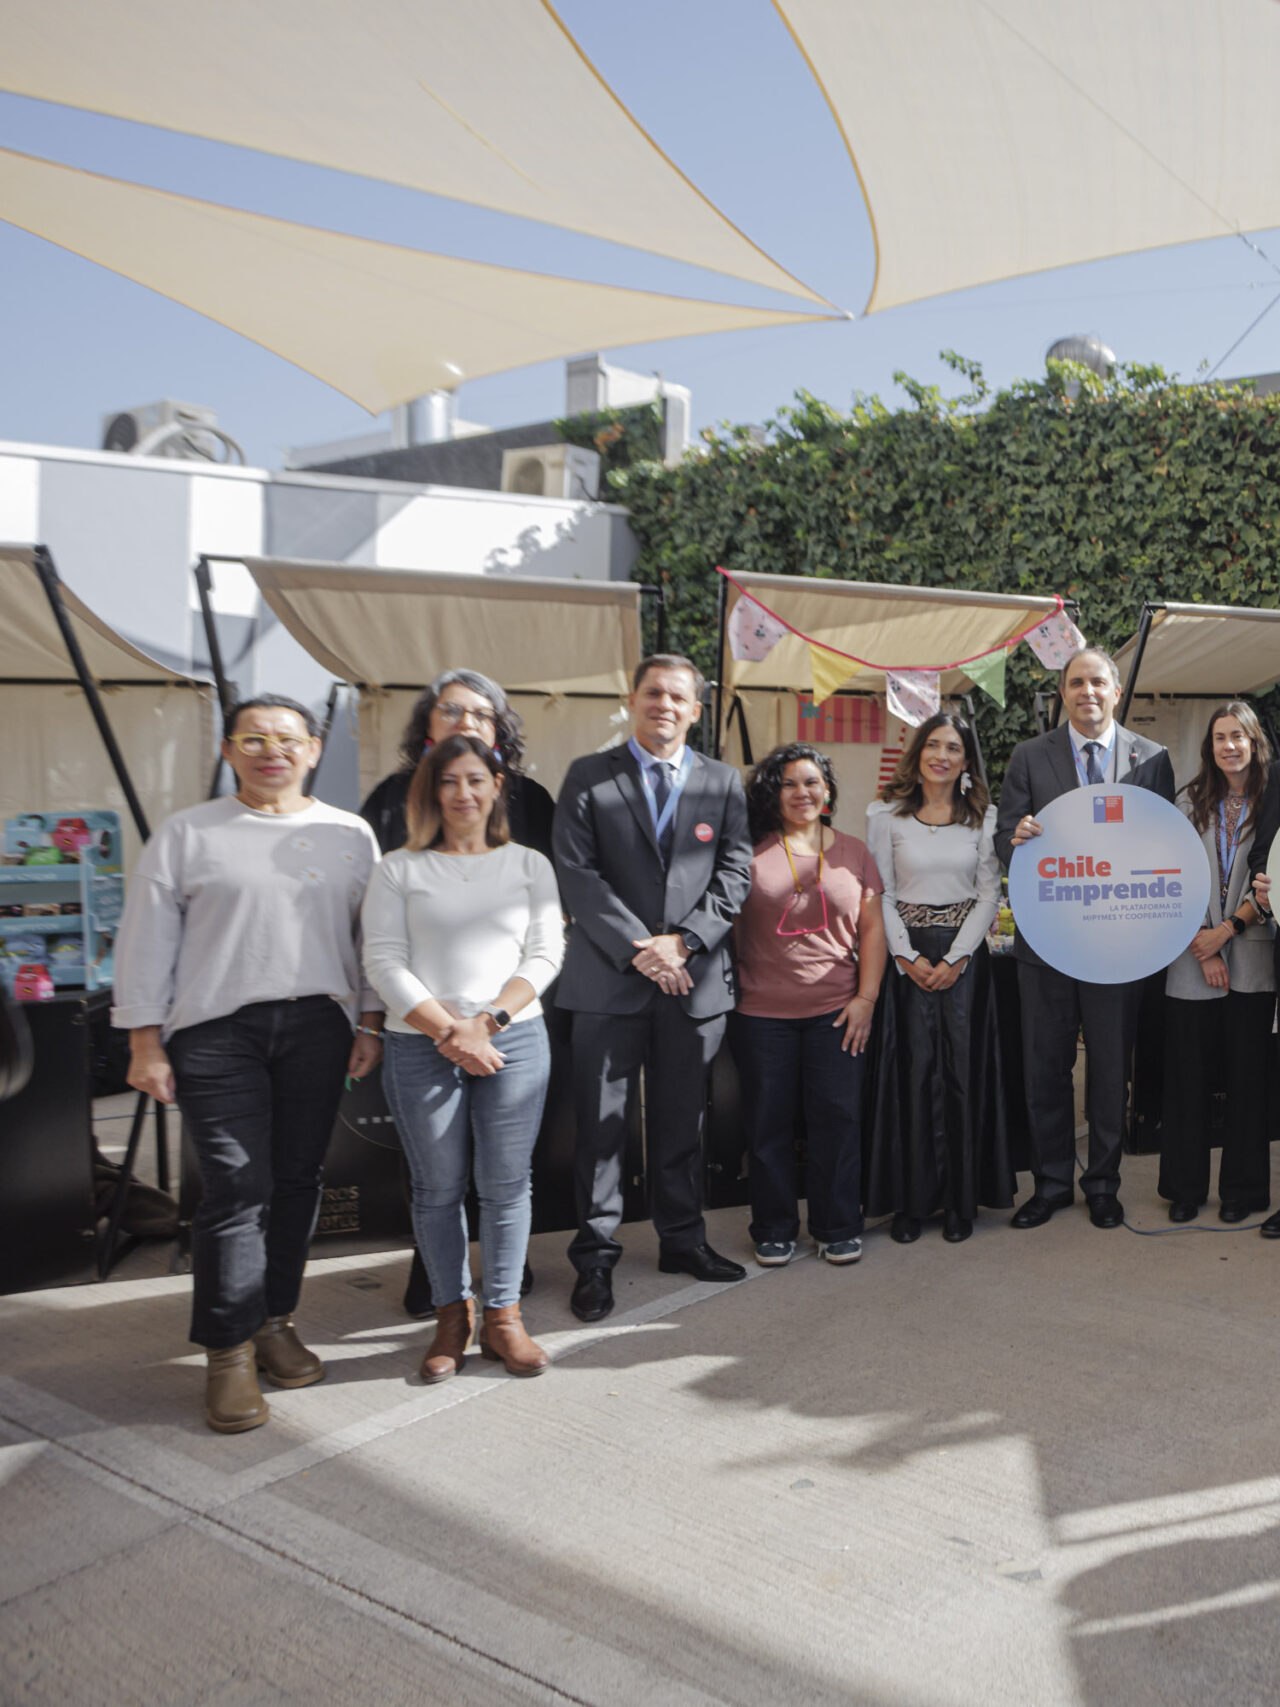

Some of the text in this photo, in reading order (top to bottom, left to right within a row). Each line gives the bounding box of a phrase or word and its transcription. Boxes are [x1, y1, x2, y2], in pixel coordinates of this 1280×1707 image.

[1037, 856, 1112, 879] Chile
[1038, 877, 1183, 906] Emprende
[1082, 914, 1117, 922] MIPYMES
[1126, 912, 1183, 920] COOPERATIVAS
